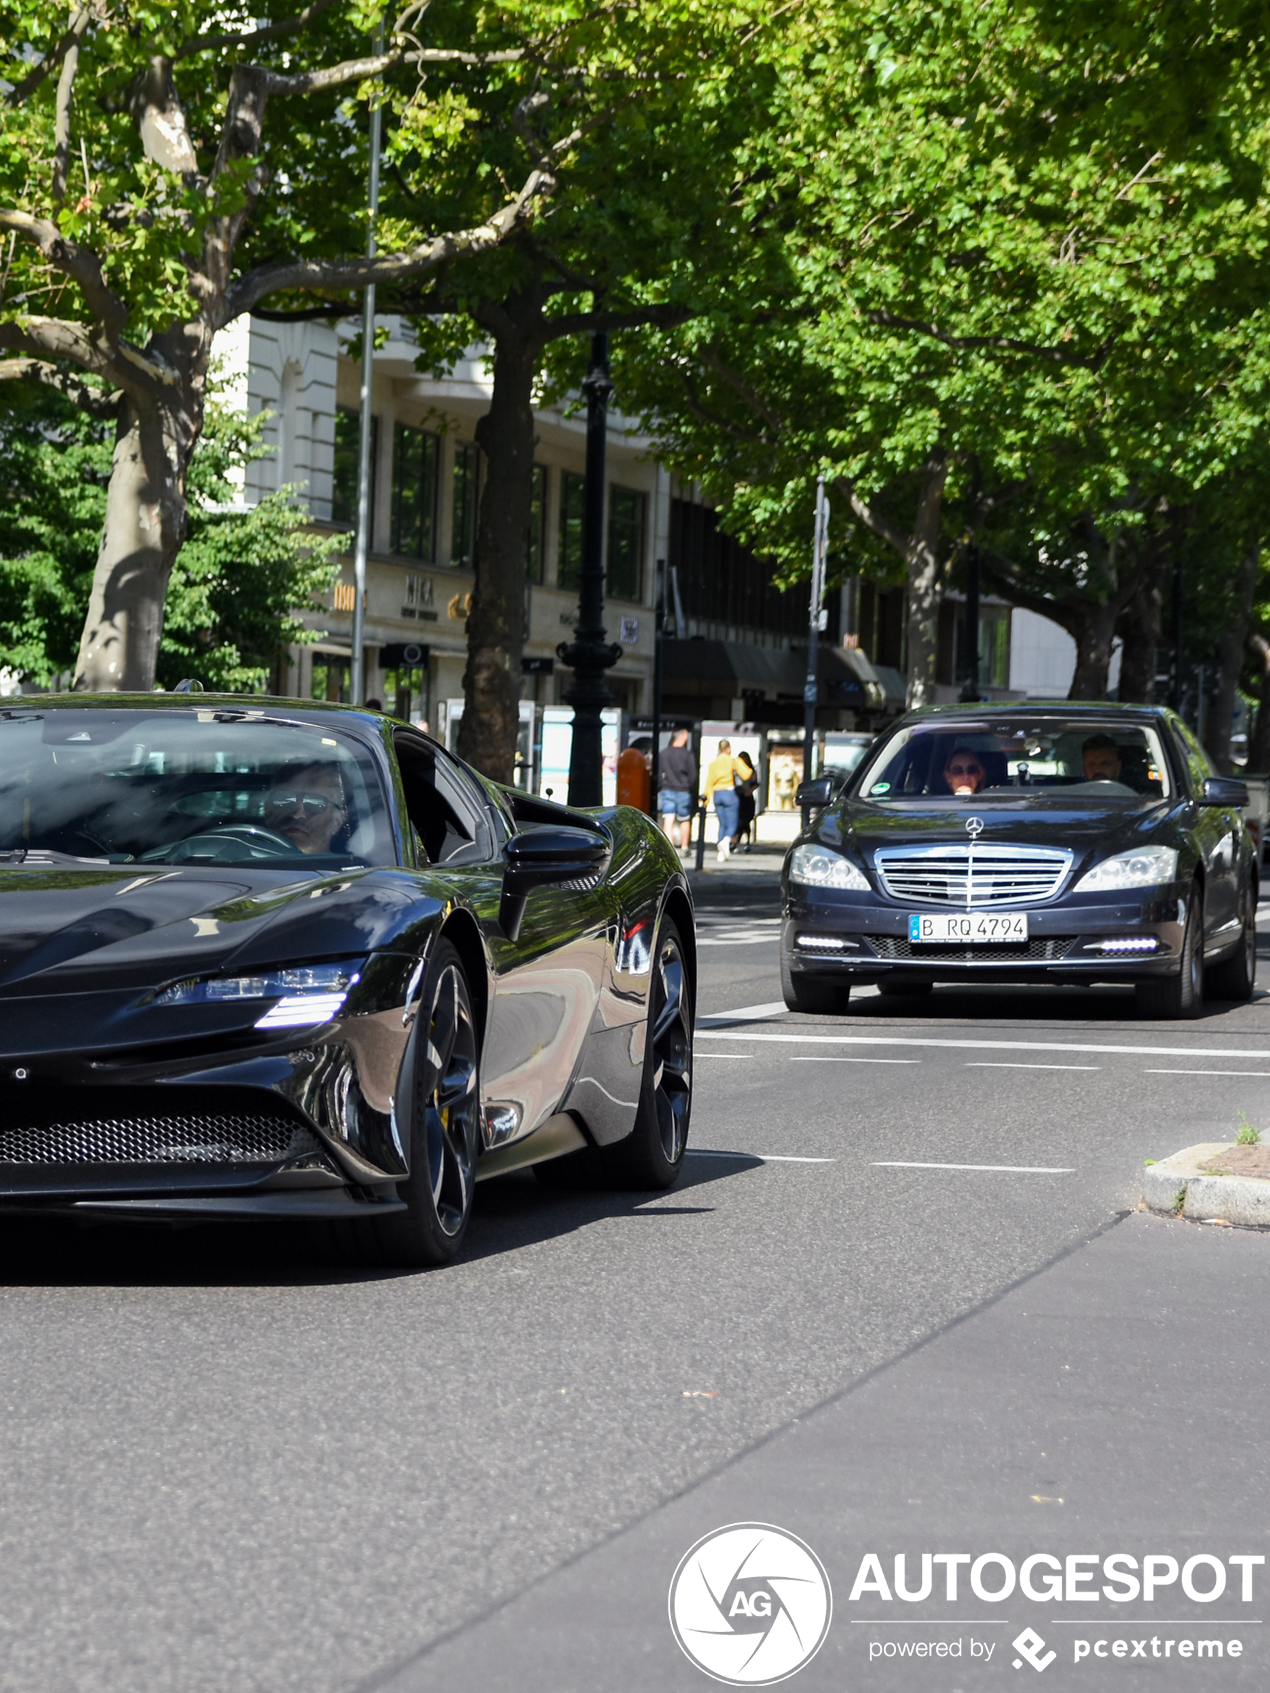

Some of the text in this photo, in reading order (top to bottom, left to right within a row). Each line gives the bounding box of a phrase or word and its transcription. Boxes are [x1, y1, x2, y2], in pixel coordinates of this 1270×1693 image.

[922, 919, 1023, 936] B RQ 4794
